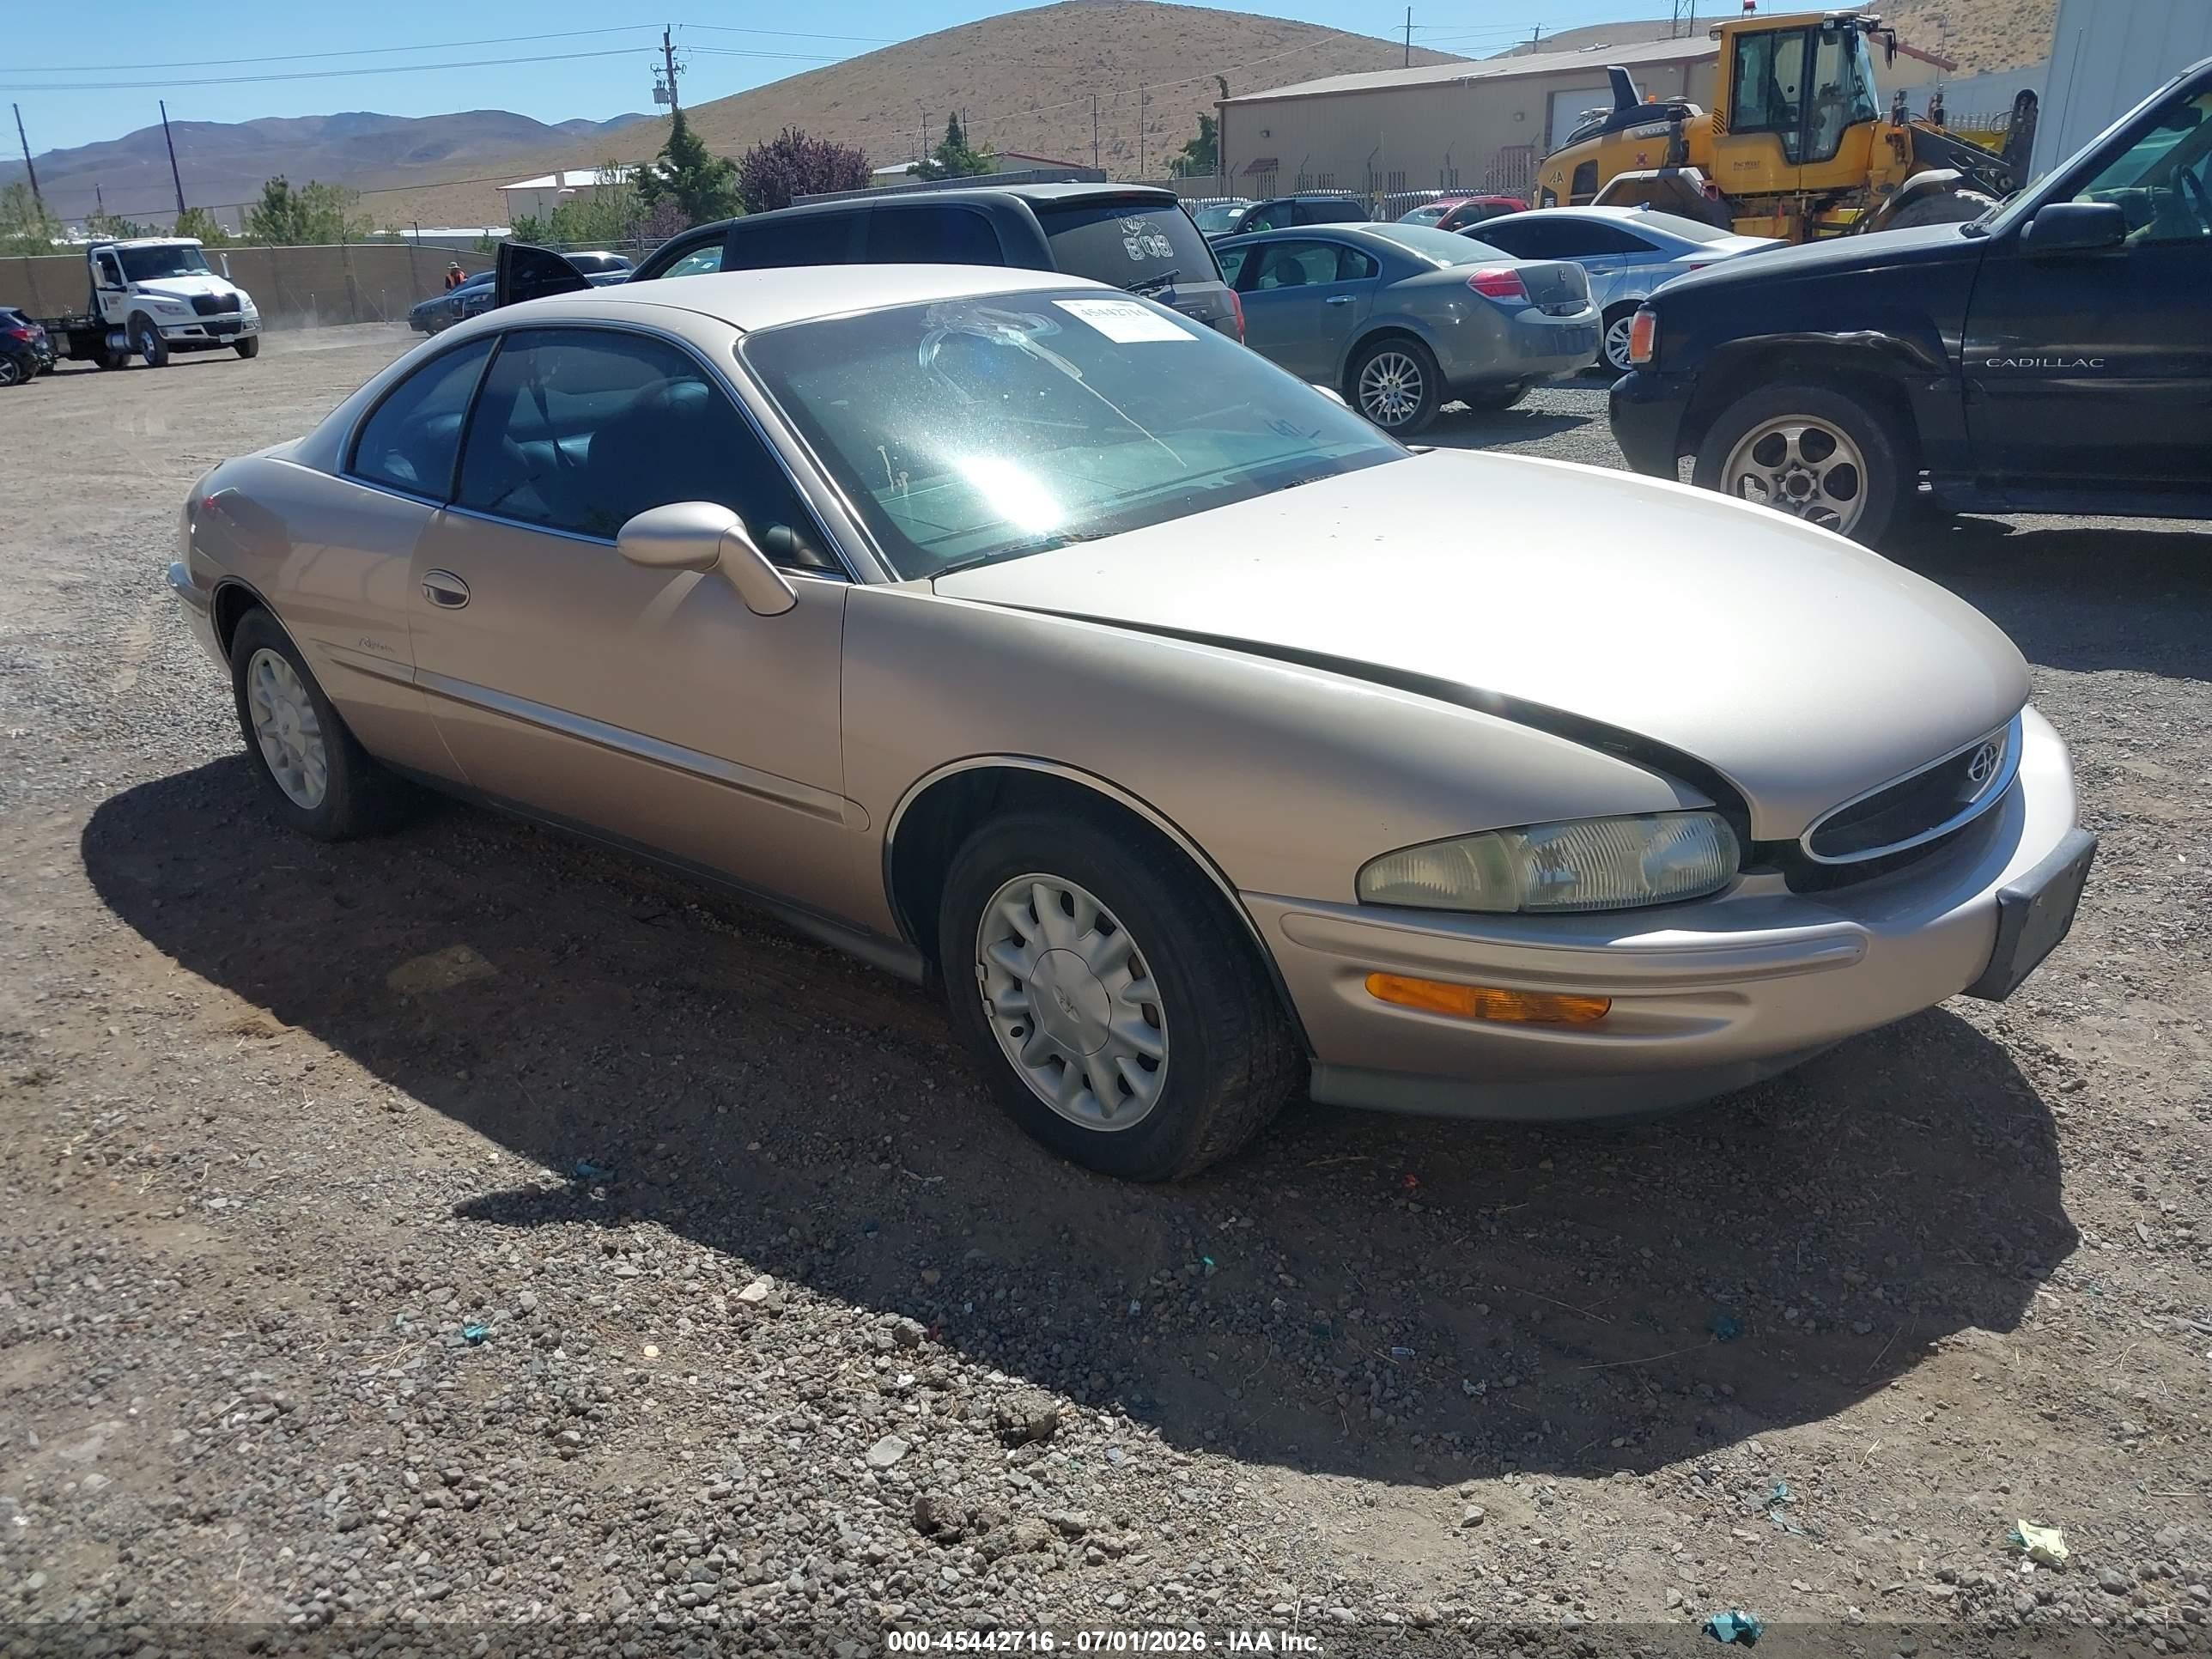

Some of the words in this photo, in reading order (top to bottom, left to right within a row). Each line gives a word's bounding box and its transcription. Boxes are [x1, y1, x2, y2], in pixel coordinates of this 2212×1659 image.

[1638, 125, 1671, 136] VOLV
[1122, 234, 1174, 261] 808
[1985, 358, 2105, 368] CADILLAC
